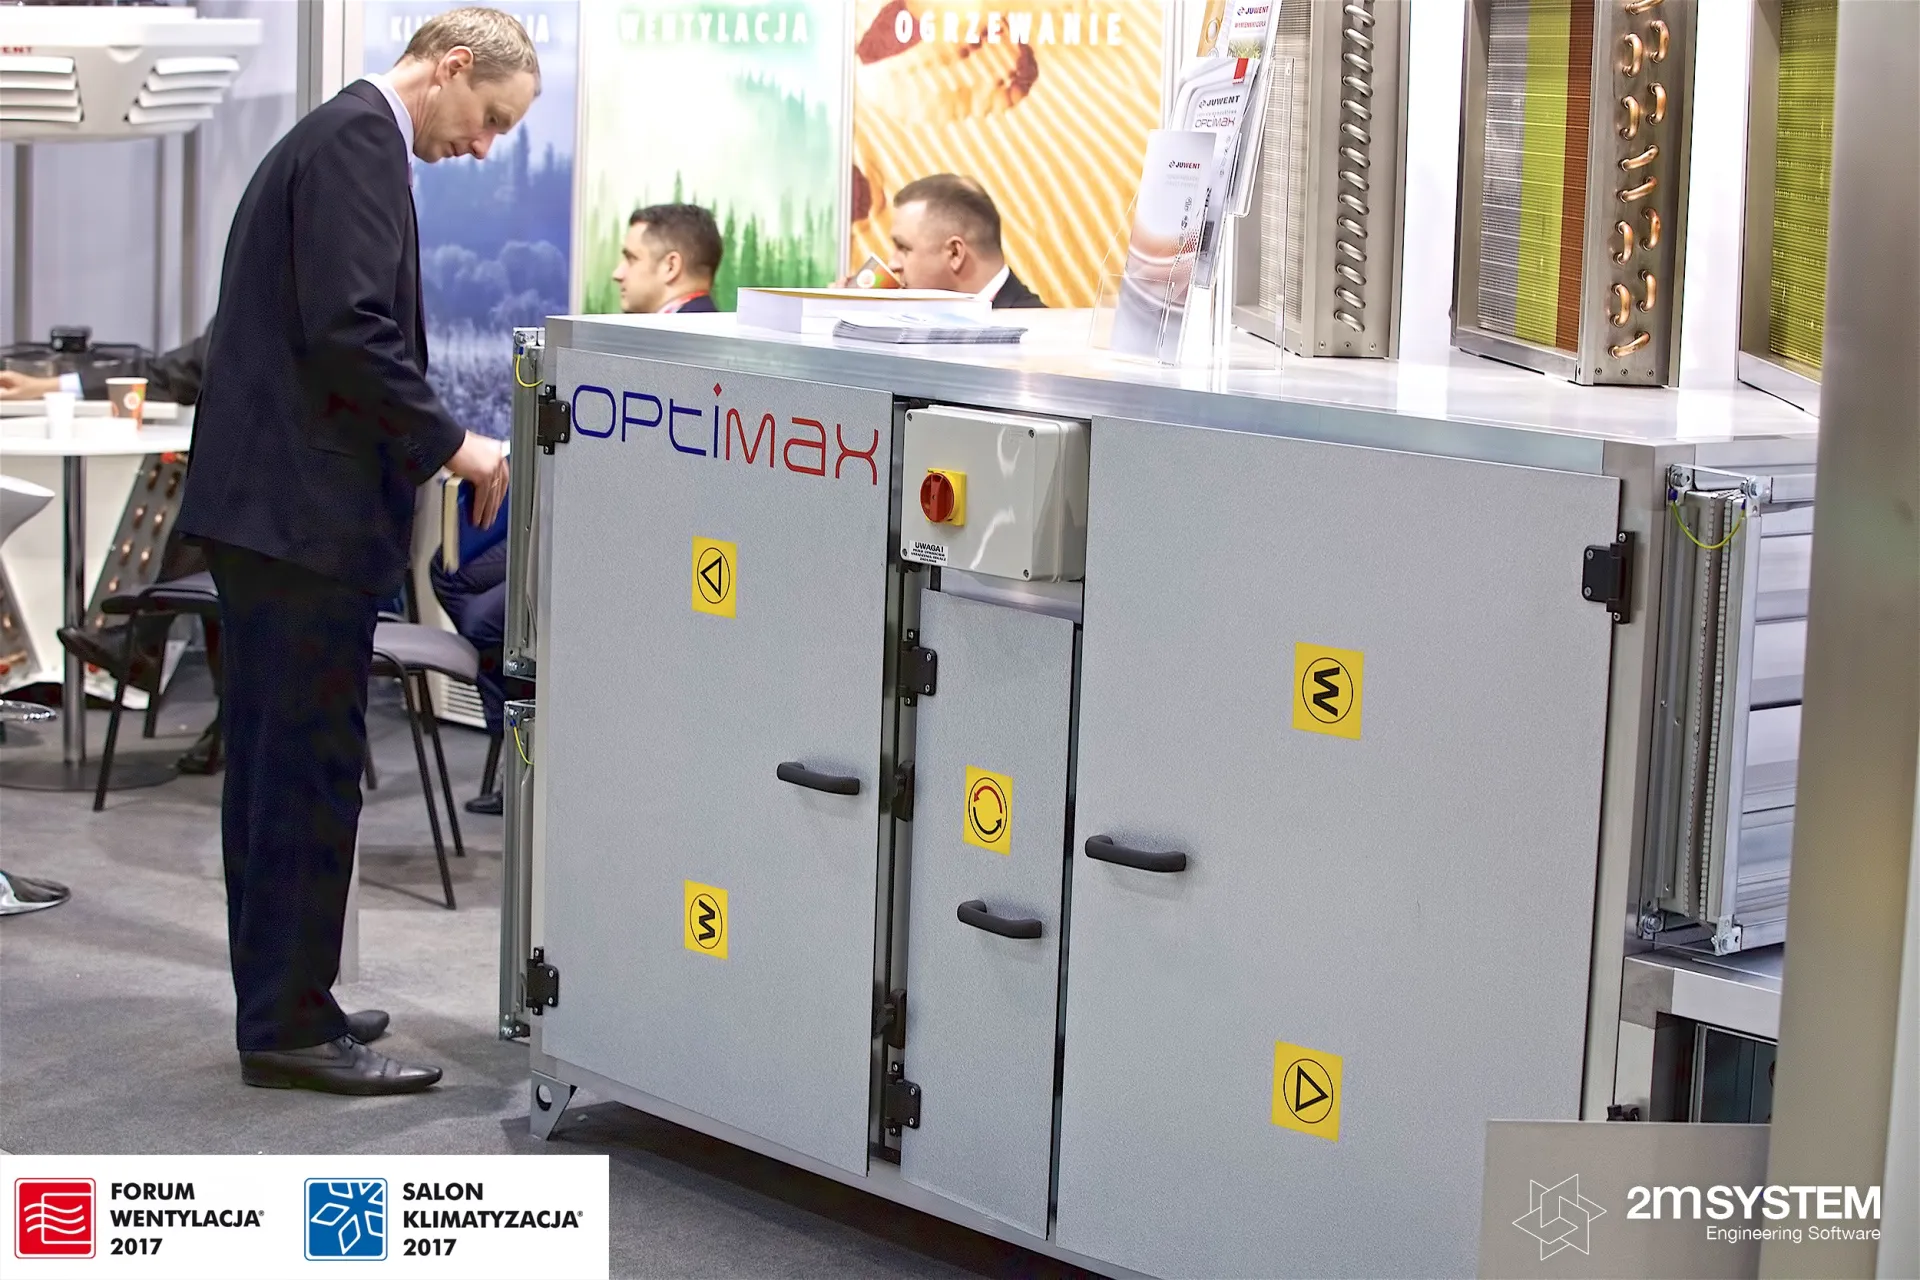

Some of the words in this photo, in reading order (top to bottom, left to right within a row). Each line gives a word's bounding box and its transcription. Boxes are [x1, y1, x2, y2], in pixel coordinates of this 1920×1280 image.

[619, 12, 809, 43] WENTYLACJA
[894, 10, 1122, 46] OGRZEWANIE
[1206, 95, 1241, 107] JUWENT
[1175, 161, 1200, 169] JUWENT
